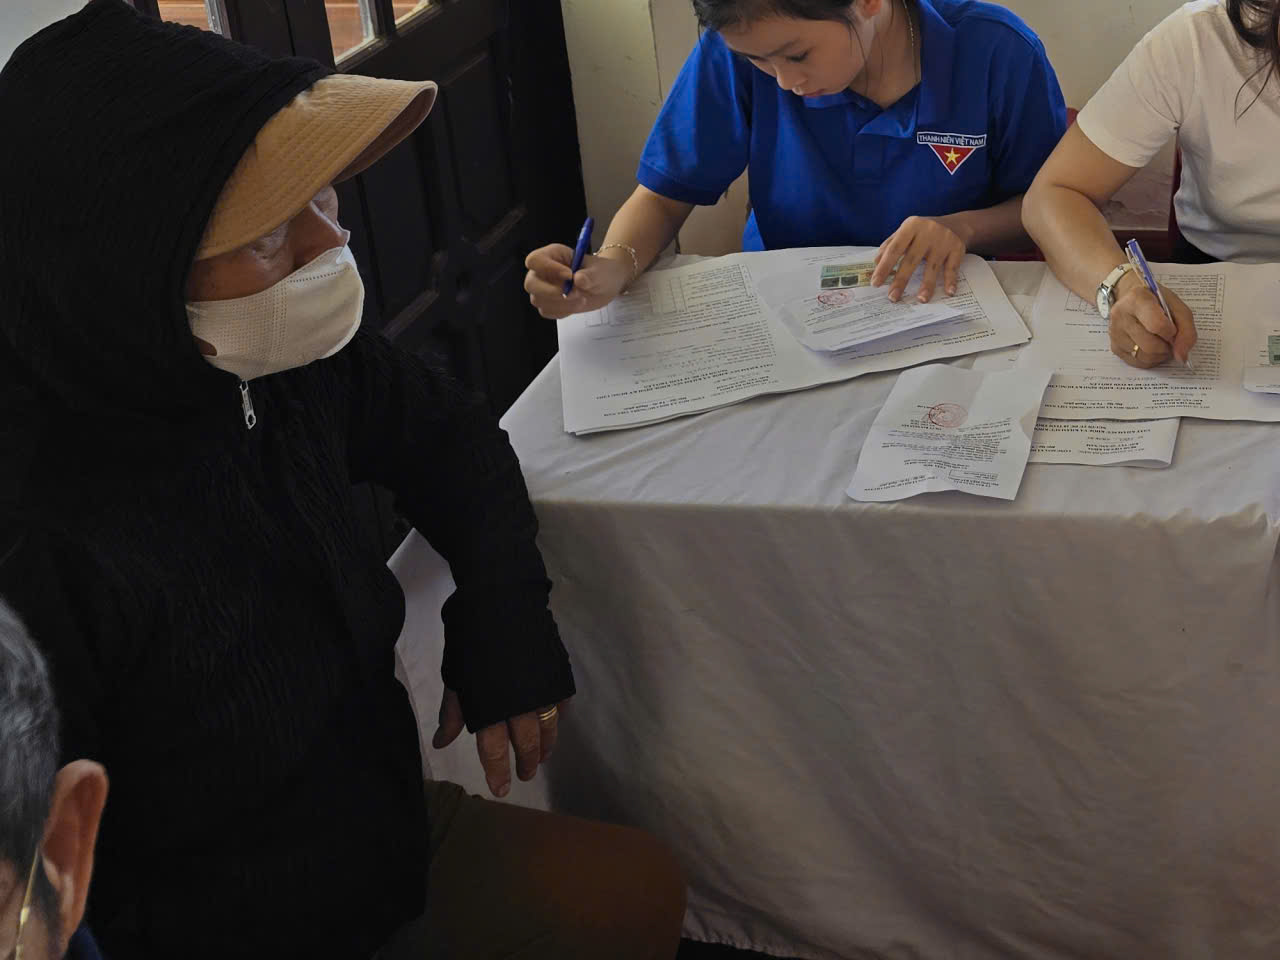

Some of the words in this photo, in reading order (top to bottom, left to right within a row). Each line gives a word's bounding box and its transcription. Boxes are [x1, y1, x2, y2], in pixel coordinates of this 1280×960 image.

[940, 135, 955, 144] NIÊN
[954, 135, 969, 146] VIỆT
[969, 138, 984, 146] NAM
